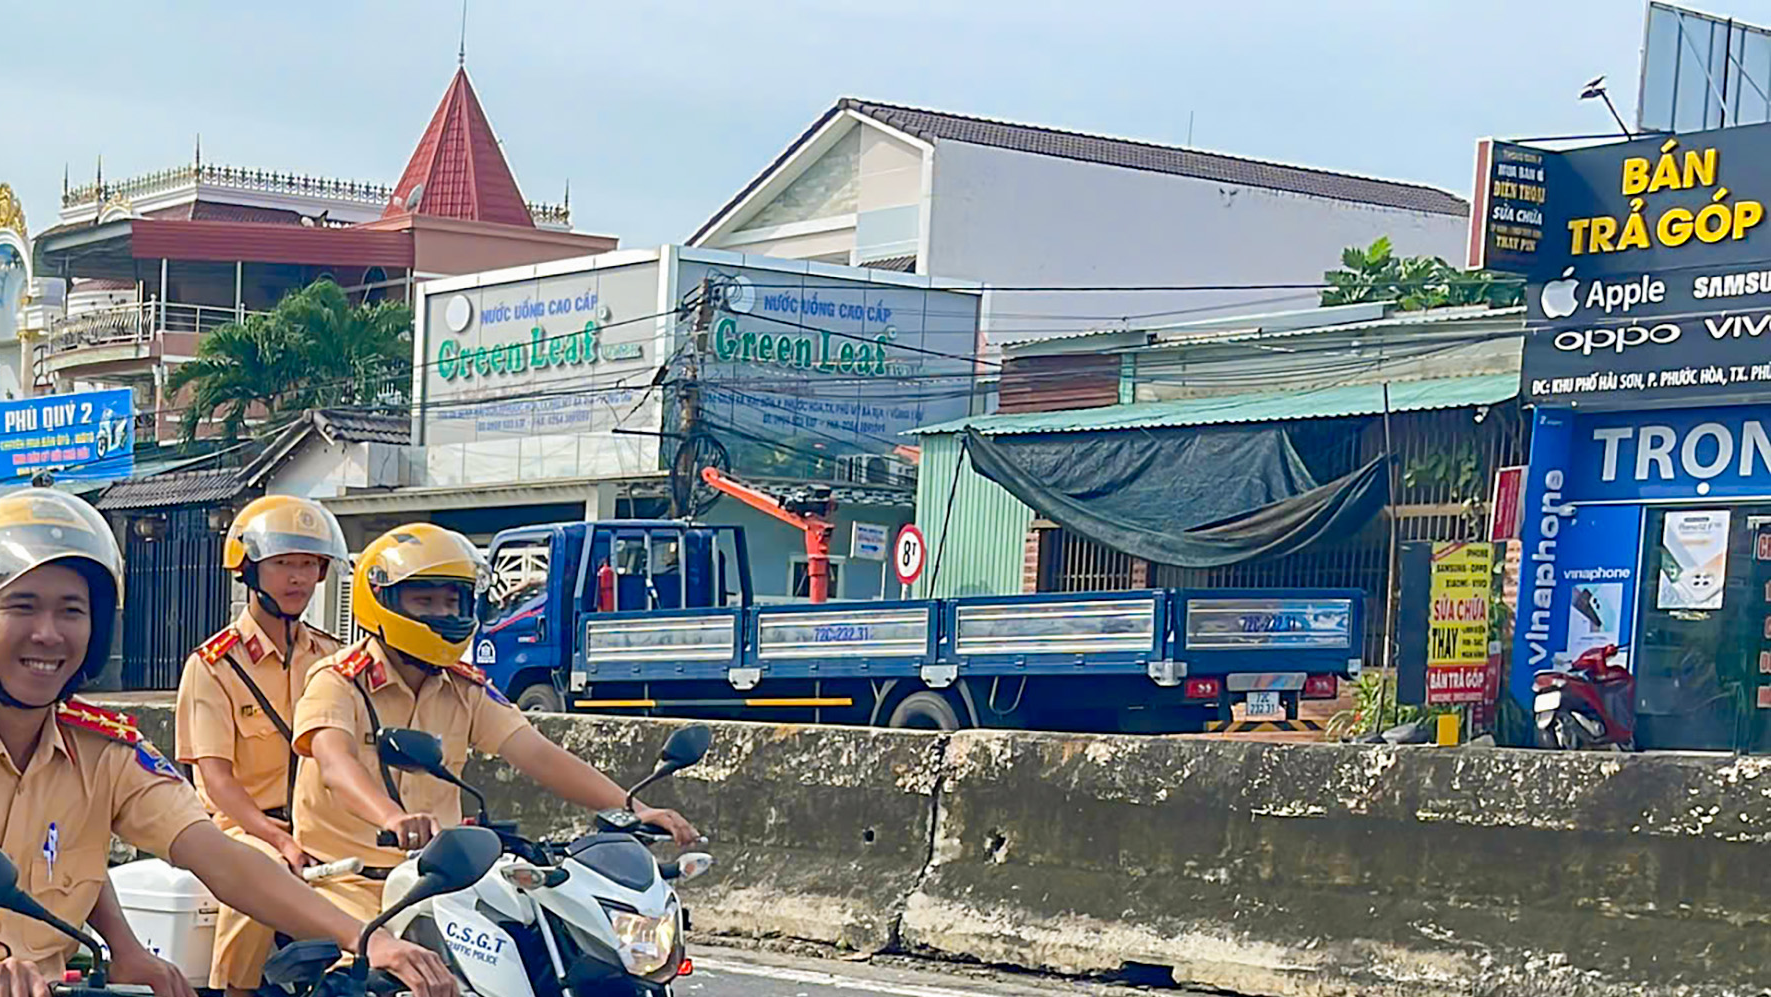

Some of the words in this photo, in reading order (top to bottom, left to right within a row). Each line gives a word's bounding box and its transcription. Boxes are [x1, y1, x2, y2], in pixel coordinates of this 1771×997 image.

[1622, 138, 1717, 196] BÁN
[1568, 198, 1651, 256] TRẢ
[1656, 187, 1764, 248] GÓP
[548, 298, 571, 315] CAO
[1585, 274, 1667, 314] Apple
[839, 303, 864, 320] CAO
[438, 338, 525, 380] Green
[530, 320, 600, 368] Leaf
[715, 317, 811, 369] Green
[818, 329, 888, 376] Leaf
[1552, 377, 1574, 394] KHU
[1575, 372, 1599, 392] PHỐ
[1648, 371, 1658, 388] P.
[1729, 366, 1749, 382] TX.
[81, 402, 92, 423] 2
[1564, 567, 1630, 581] vinaphone
[1432, 627, 1459, 659] THAY
[447, 922, 507, 953] C.S.G.T
